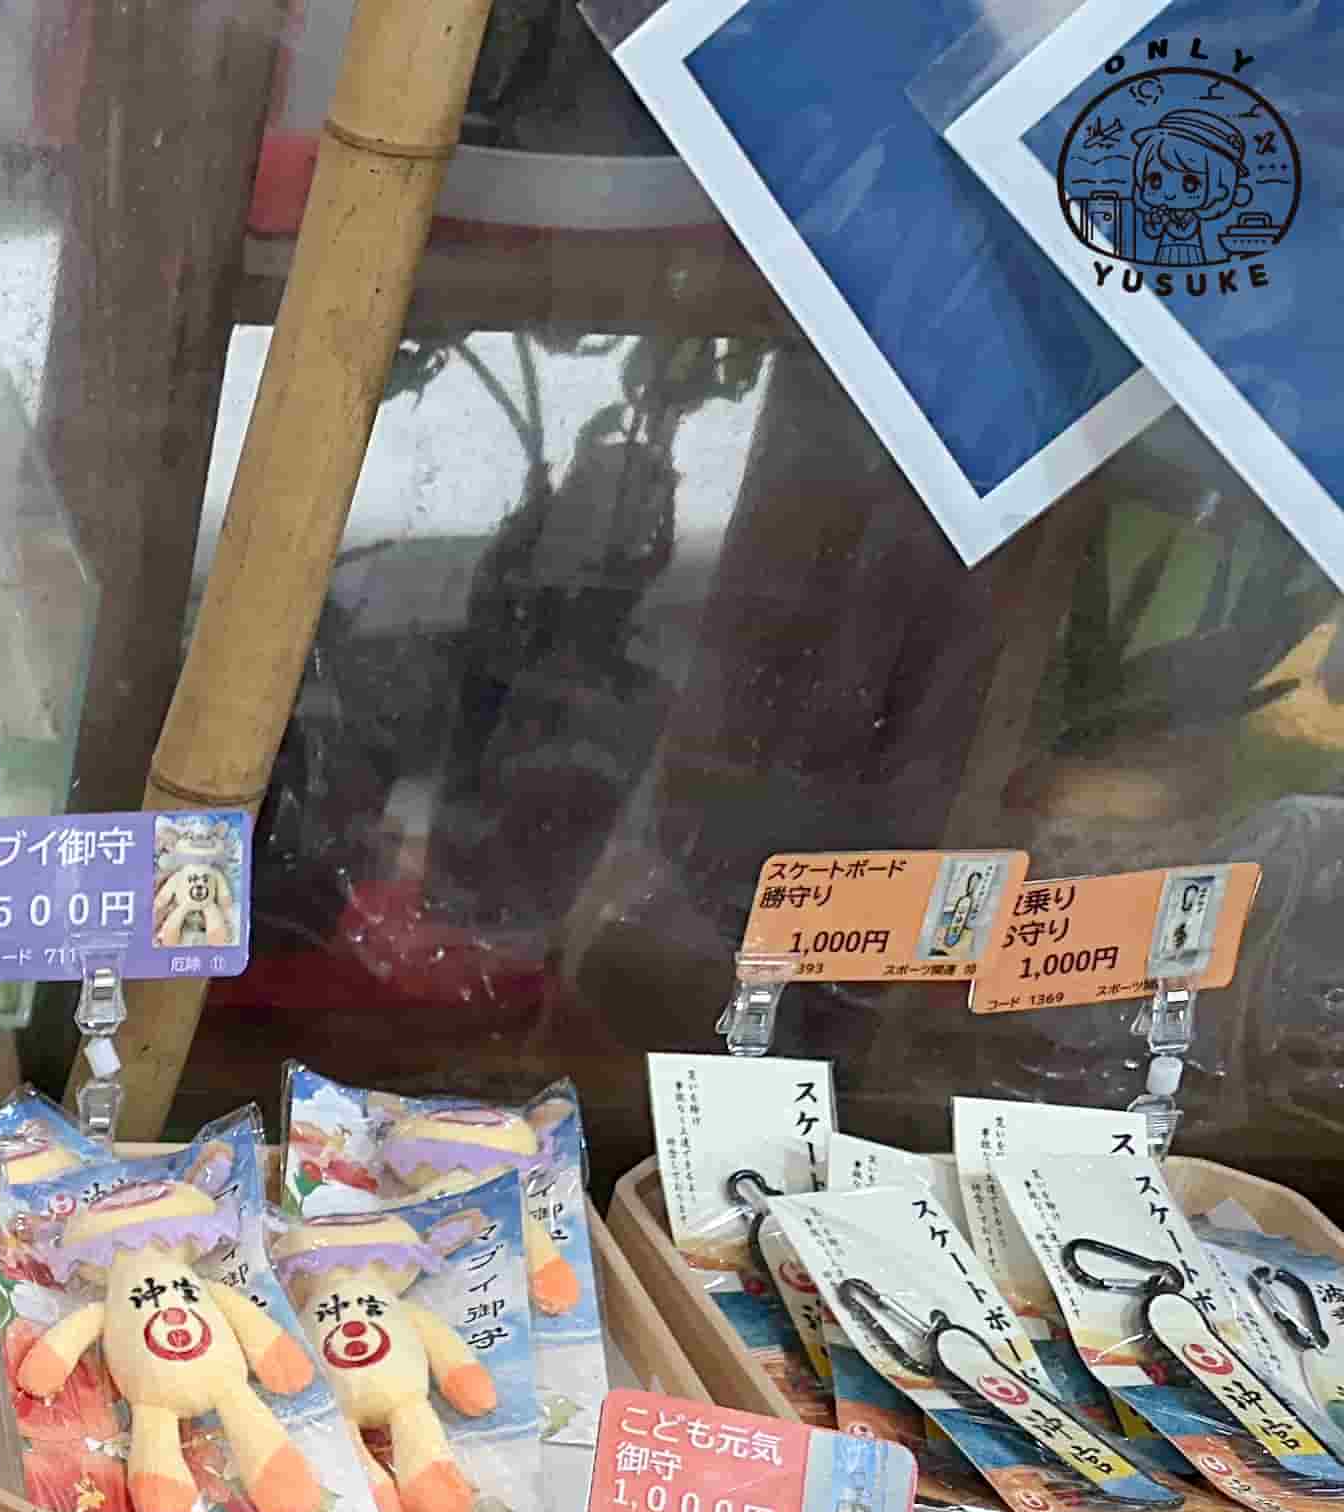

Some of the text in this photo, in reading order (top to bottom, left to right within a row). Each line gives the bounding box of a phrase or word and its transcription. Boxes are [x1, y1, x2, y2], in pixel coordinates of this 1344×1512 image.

[768, 859, 908, 881] スケートボード
[760, 885, 833, 909] 勝守り
[789, 930, 890, 957] 1,000円
[1018, 946, 1119, 980] 1,000円
[1029, 992, 1064, 1006] 1369
[464, 1225, 509, 1351] マブイ御守
[620, 1404, 784, 1466] こども元気
[615, 1442, 683, 1481] 御守
